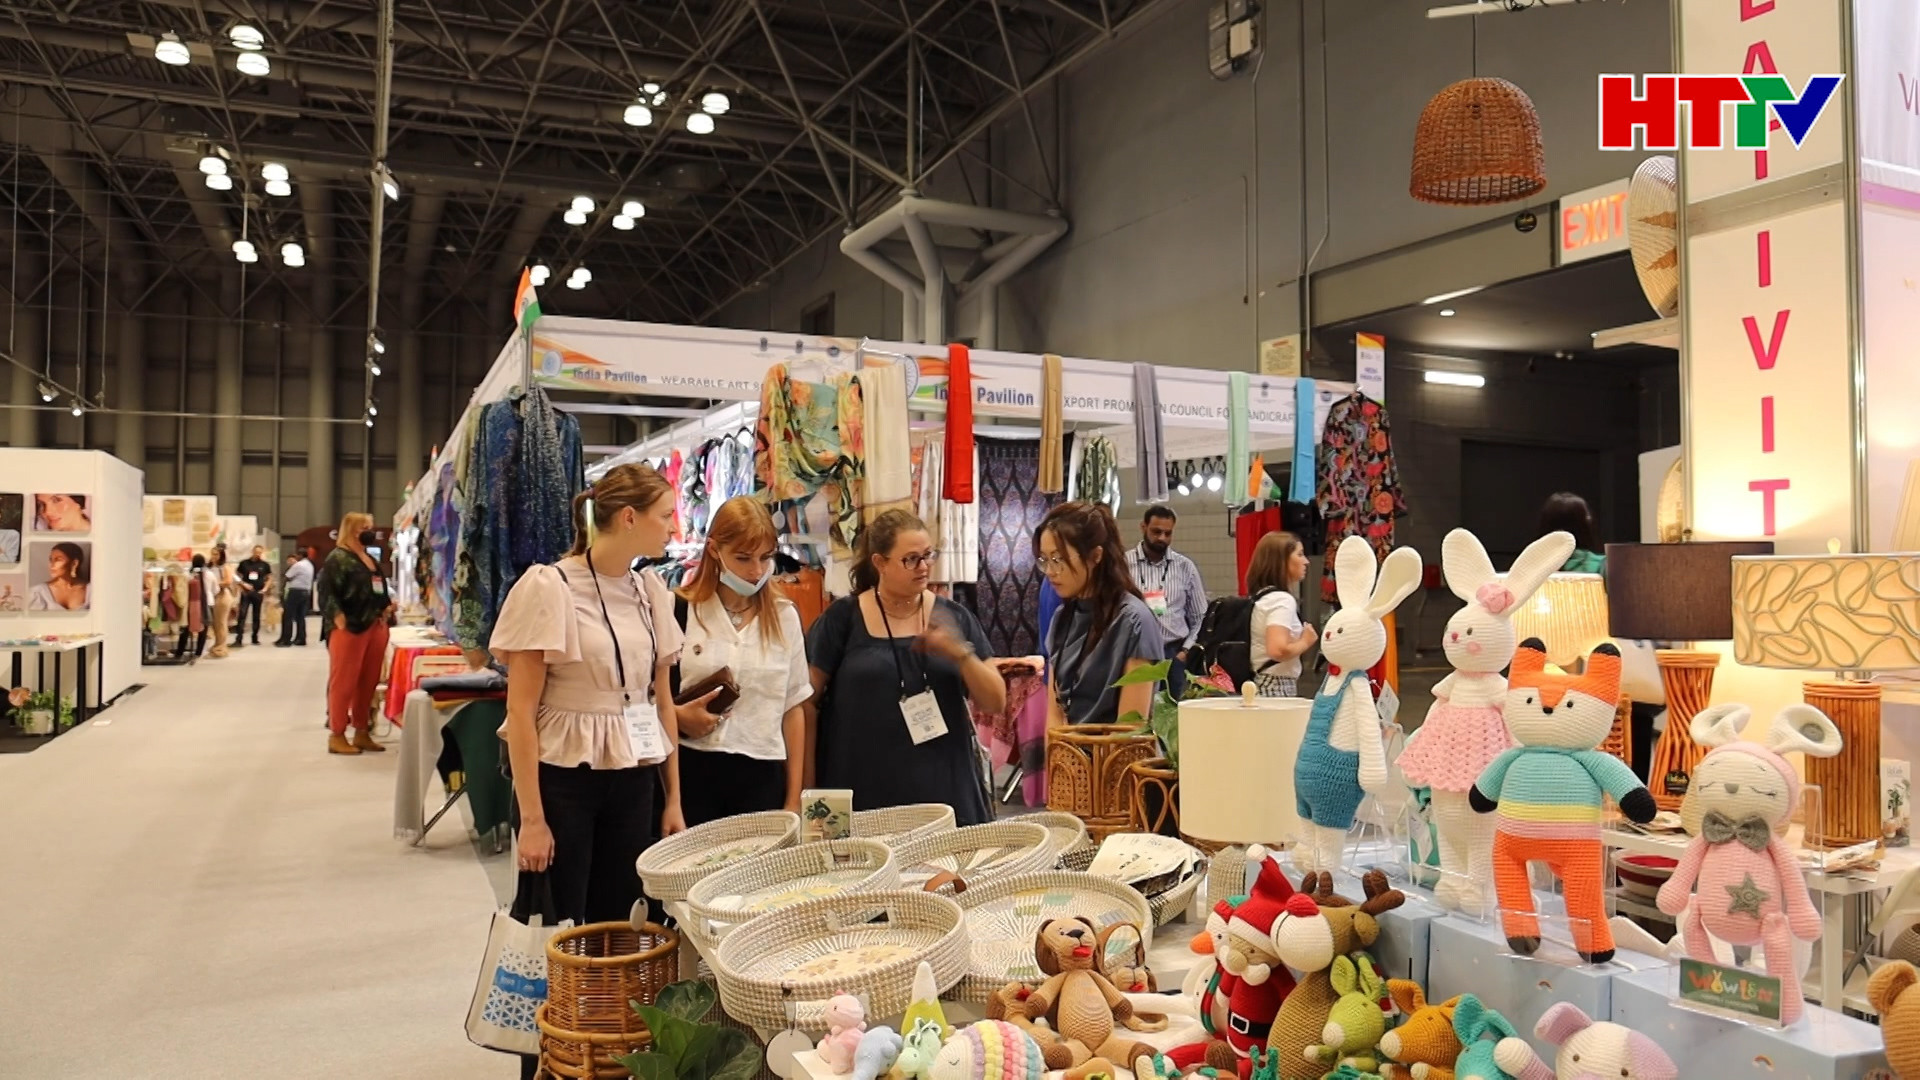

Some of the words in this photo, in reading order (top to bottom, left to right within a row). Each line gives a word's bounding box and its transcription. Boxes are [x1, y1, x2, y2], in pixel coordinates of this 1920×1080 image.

[1563, 192, 1628, 250] EXIT
[573, 368, 601, 380] India
[604, 370, 648, 384] Pavilion
[660, 375, 724, 388] WEARABLE
[727, 381, 749, 391] ART
[977, 385, 1034, 406] Pavilion
[1063, 396, 1100, 410] XPORT
[1169, 403, 1214, 418] COUNCIL
[1216, 407, 1232, 420] FO
[1247, 410, 1297, 423] ANDICRAF
